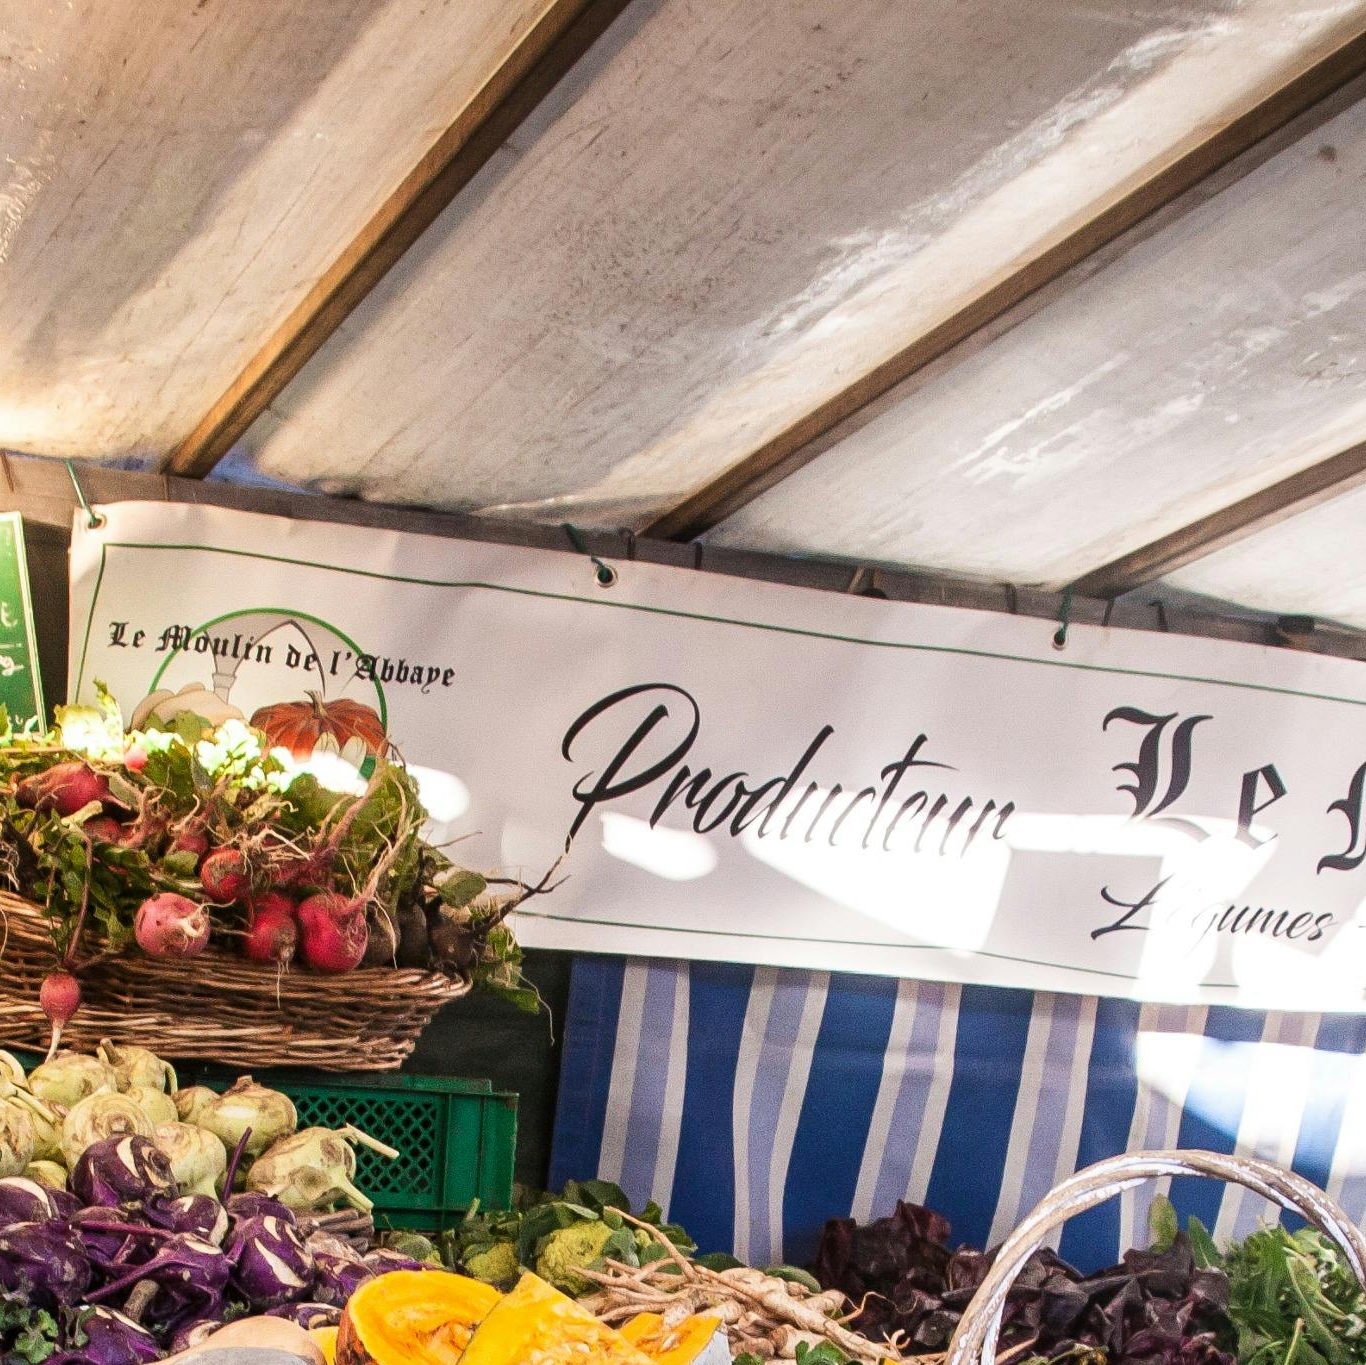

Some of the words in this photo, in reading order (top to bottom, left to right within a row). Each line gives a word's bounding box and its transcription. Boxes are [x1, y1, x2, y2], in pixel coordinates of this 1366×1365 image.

[109, 621, 146, 649] Le
[155, 624, 273, 664] Moulin
[285, 644, 318, 671] de
[329, 650, 456, 694] l'Abbaye
[561, 683, 1018, 859] Producteur
[1102, 706, 1289, 850] Le
[1090, 873, 1339, 957] Lgumes
